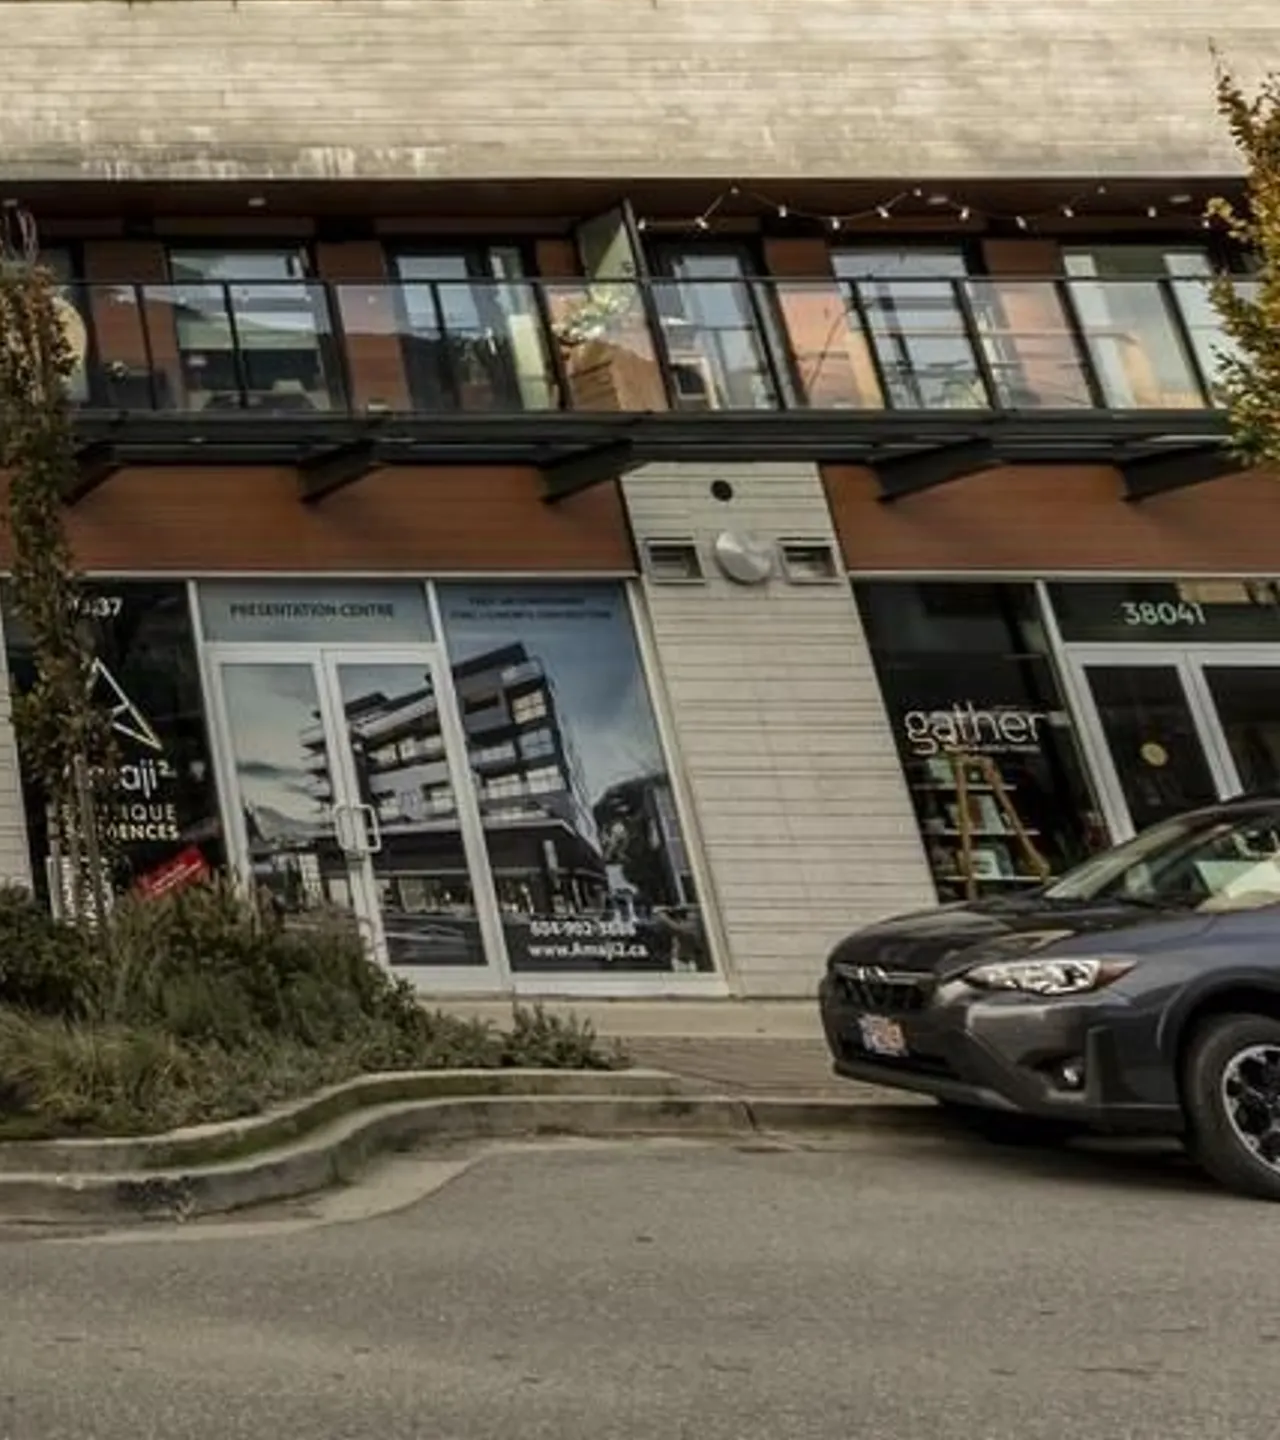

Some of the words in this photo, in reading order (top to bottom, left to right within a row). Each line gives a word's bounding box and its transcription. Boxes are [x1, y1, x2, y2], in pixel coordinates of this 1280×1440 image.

[230, 603, 337, 617] PRESENTATION
[341, 603, 394, 617] CENTRE
[1120, 601, 1206, 626] 38041
[904, 700, 1048, 754] gather
